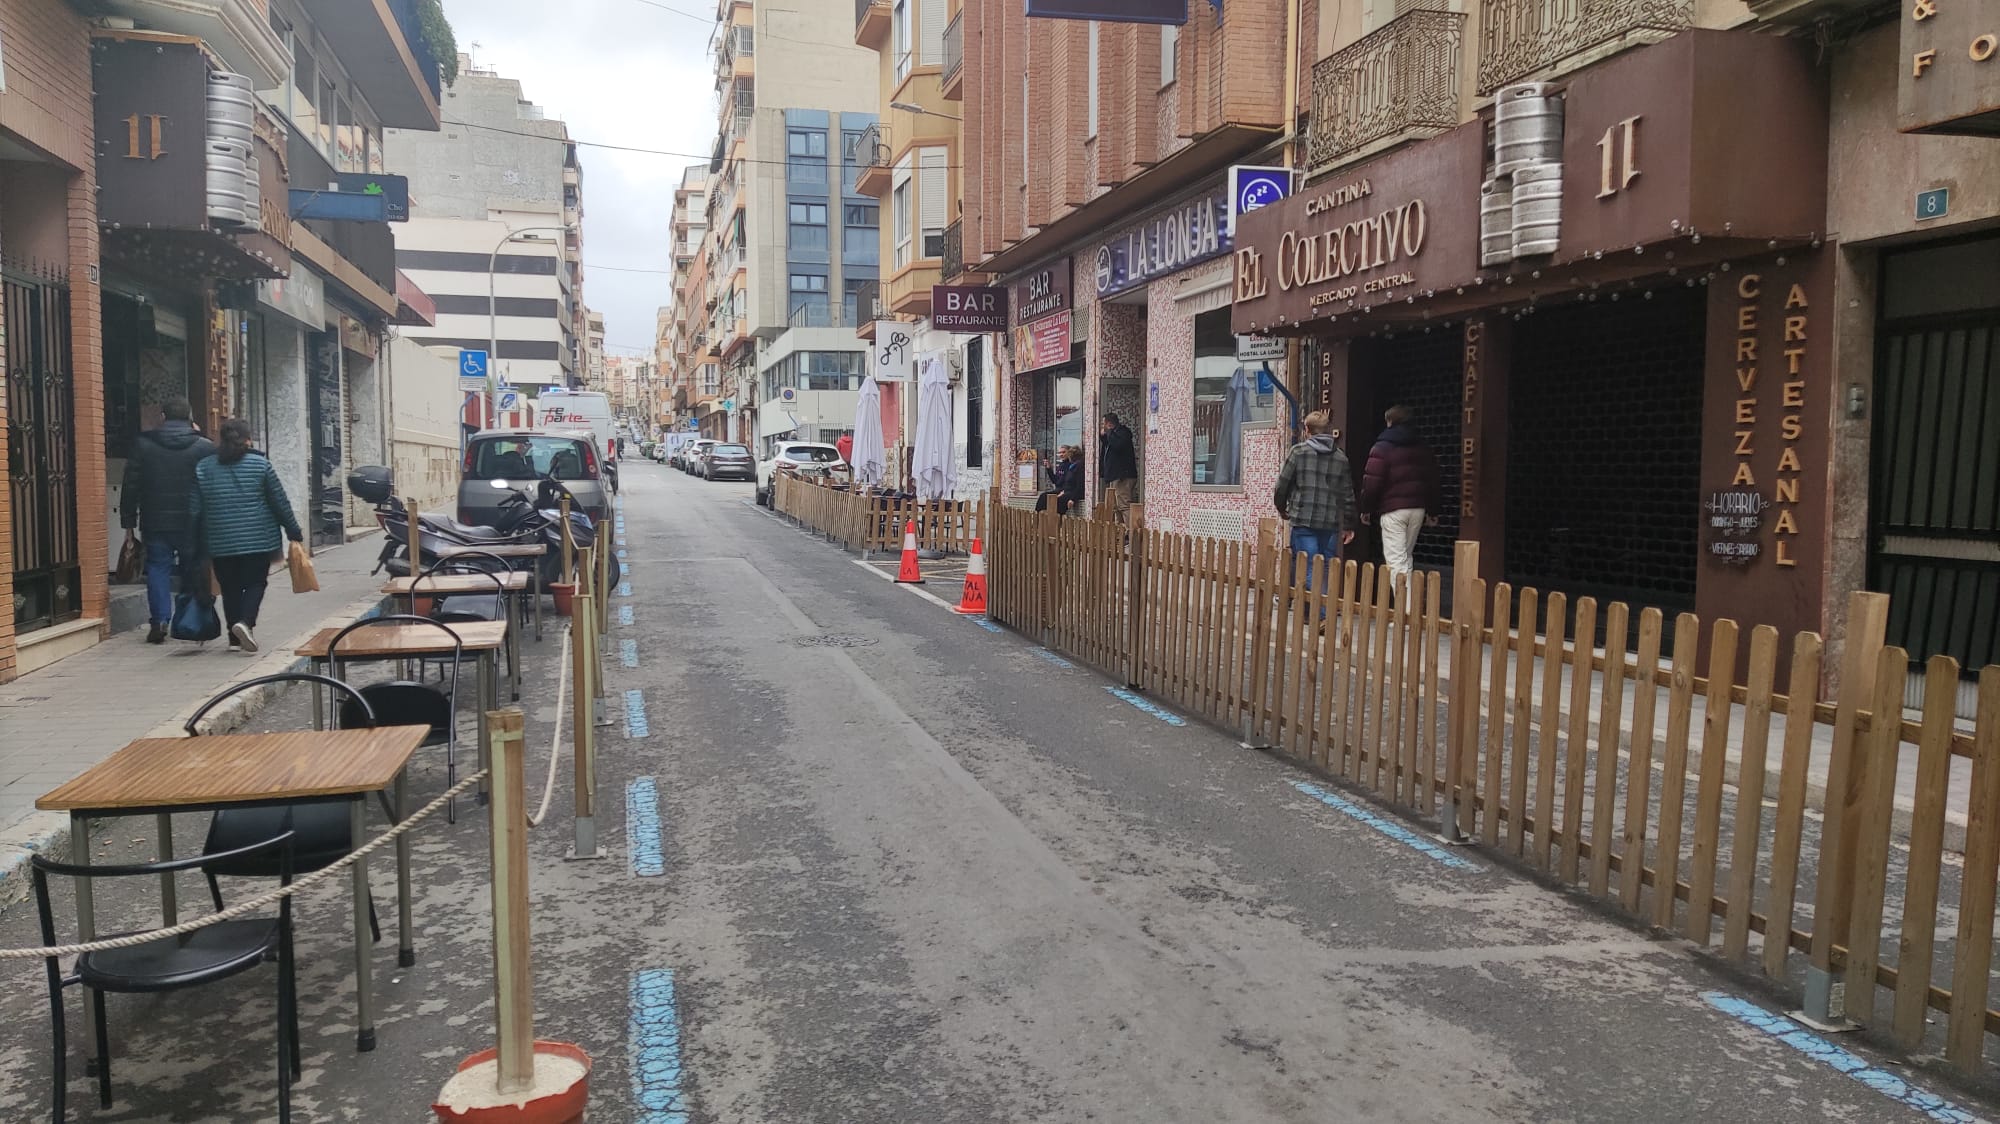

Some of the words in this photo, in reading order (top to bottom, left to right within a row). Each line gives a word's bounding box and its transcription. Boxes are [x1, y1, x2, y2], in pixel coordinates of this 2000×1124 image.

[1305, 178, 1373, 216] CANTINA
[1927, 196, 1936, 213] 8
[1128, 227, 1148, 281] LA
[1155, 197, 1219, 272] LONJA
[947, 292, 995, 312] BAR
[1029, 271, 1049, 301] BAR
[1309, 286, 1358, 307] MERCADO
[1364, 271, 1416, 294] CENTRAL
[936, 314, 1006, 326] RESTAURANTE
[1020, 293, 1062, 320] RESTAURANTE
[1465, 325, 1479, 425] CRAFT
[1732, 274, 1761, 486] CERVEZA
[1774, 283, 1809, 567] ARTESANAL
[1462, 438, 1475, 517] BEER
[1712, 492, 1761, 514] HORARIO
